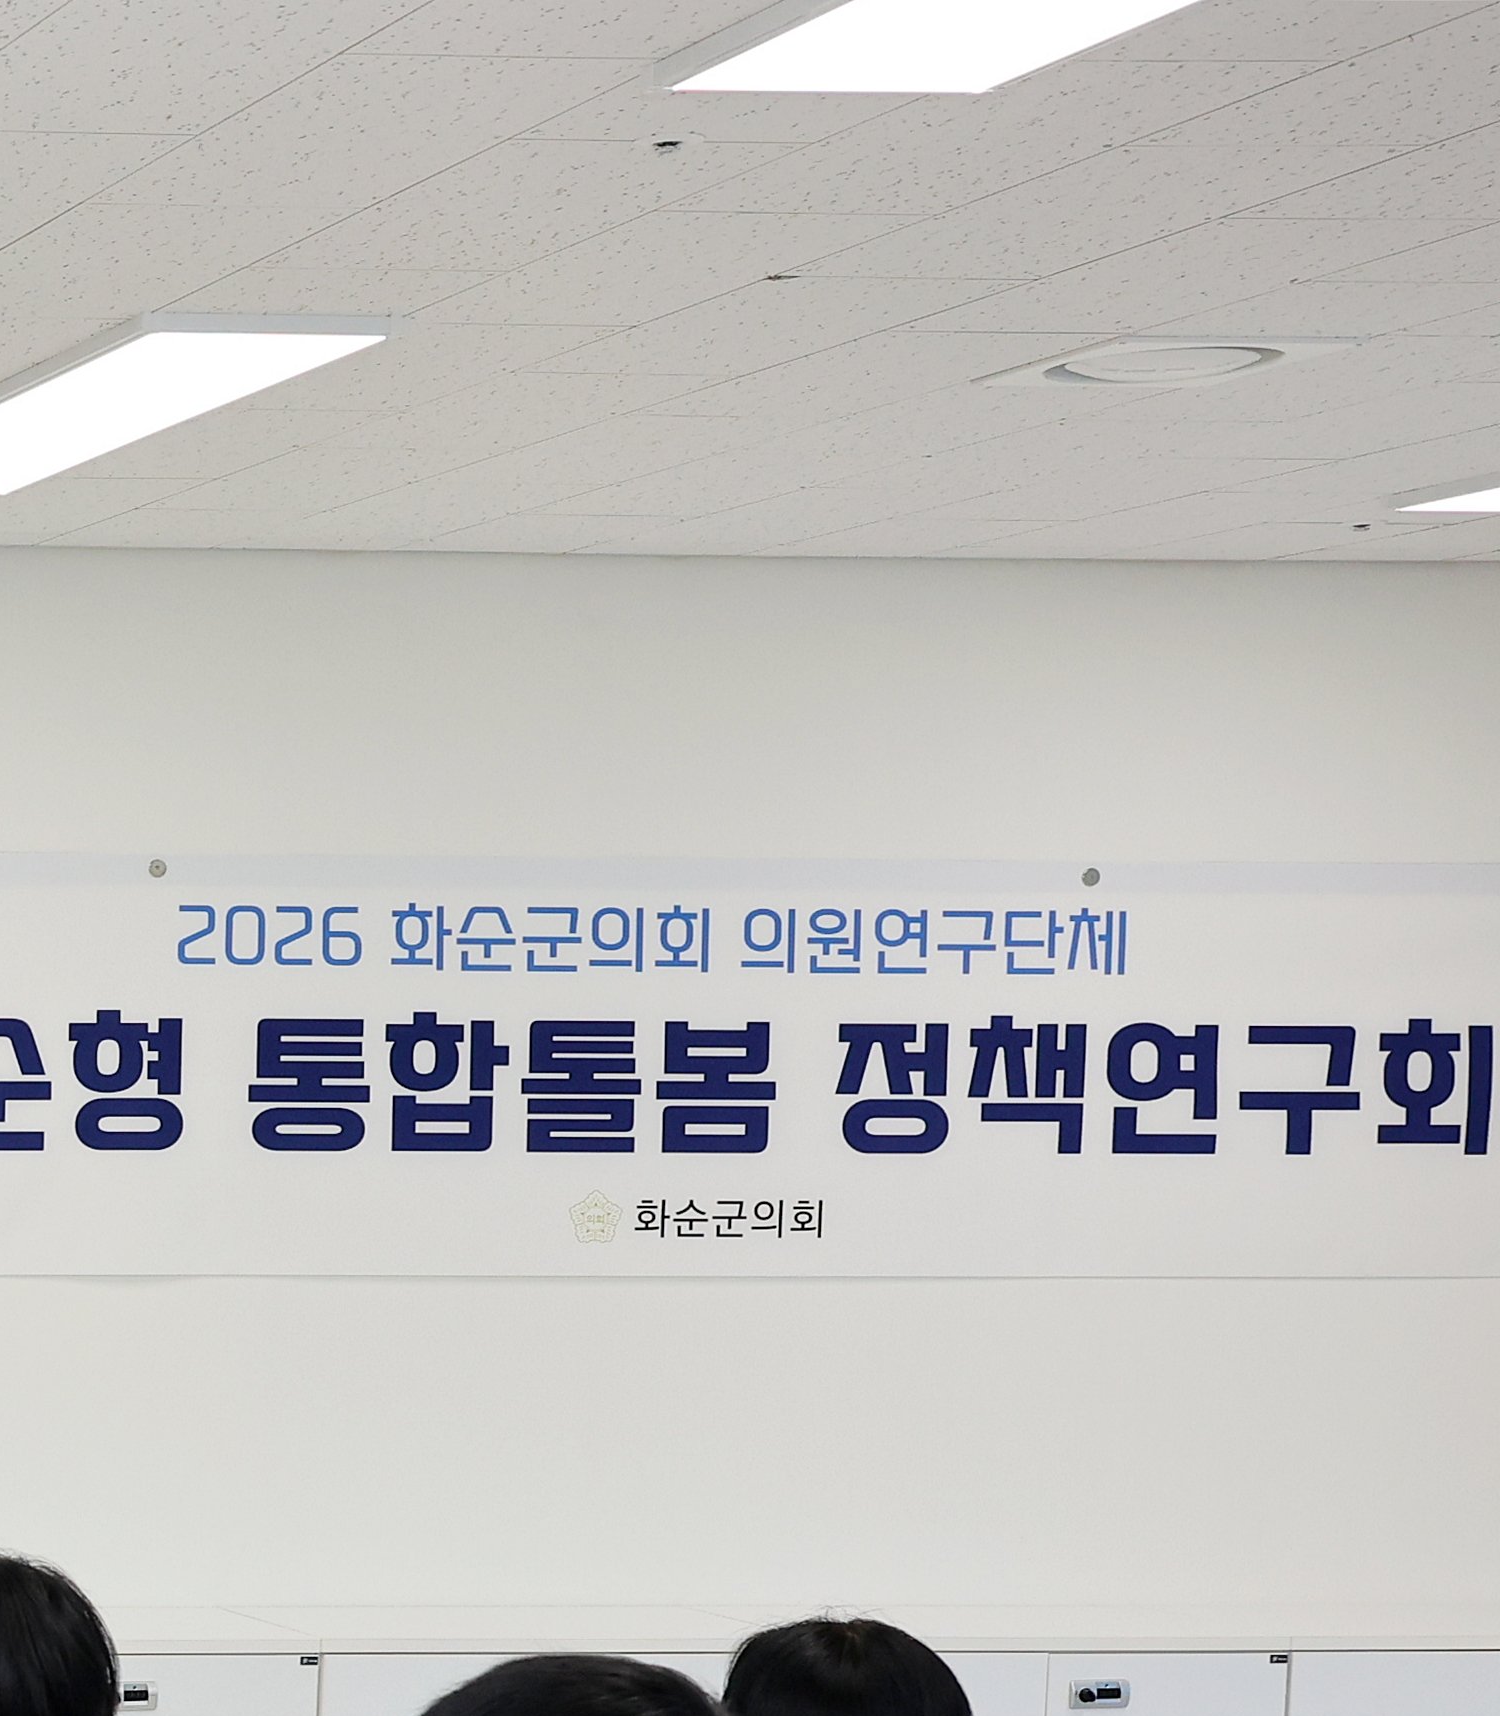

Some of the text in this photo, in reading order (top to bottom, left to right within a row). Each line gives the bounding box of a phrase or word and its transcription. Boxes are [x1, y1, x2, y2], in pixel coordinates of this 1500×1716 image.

[179, 903, 1128, 975] 2026 화순군의회 의원연구단체
[835, 1015, 1494, 1156] 정책연구회
[634, 1199, 824, 1239] 화순군의회
